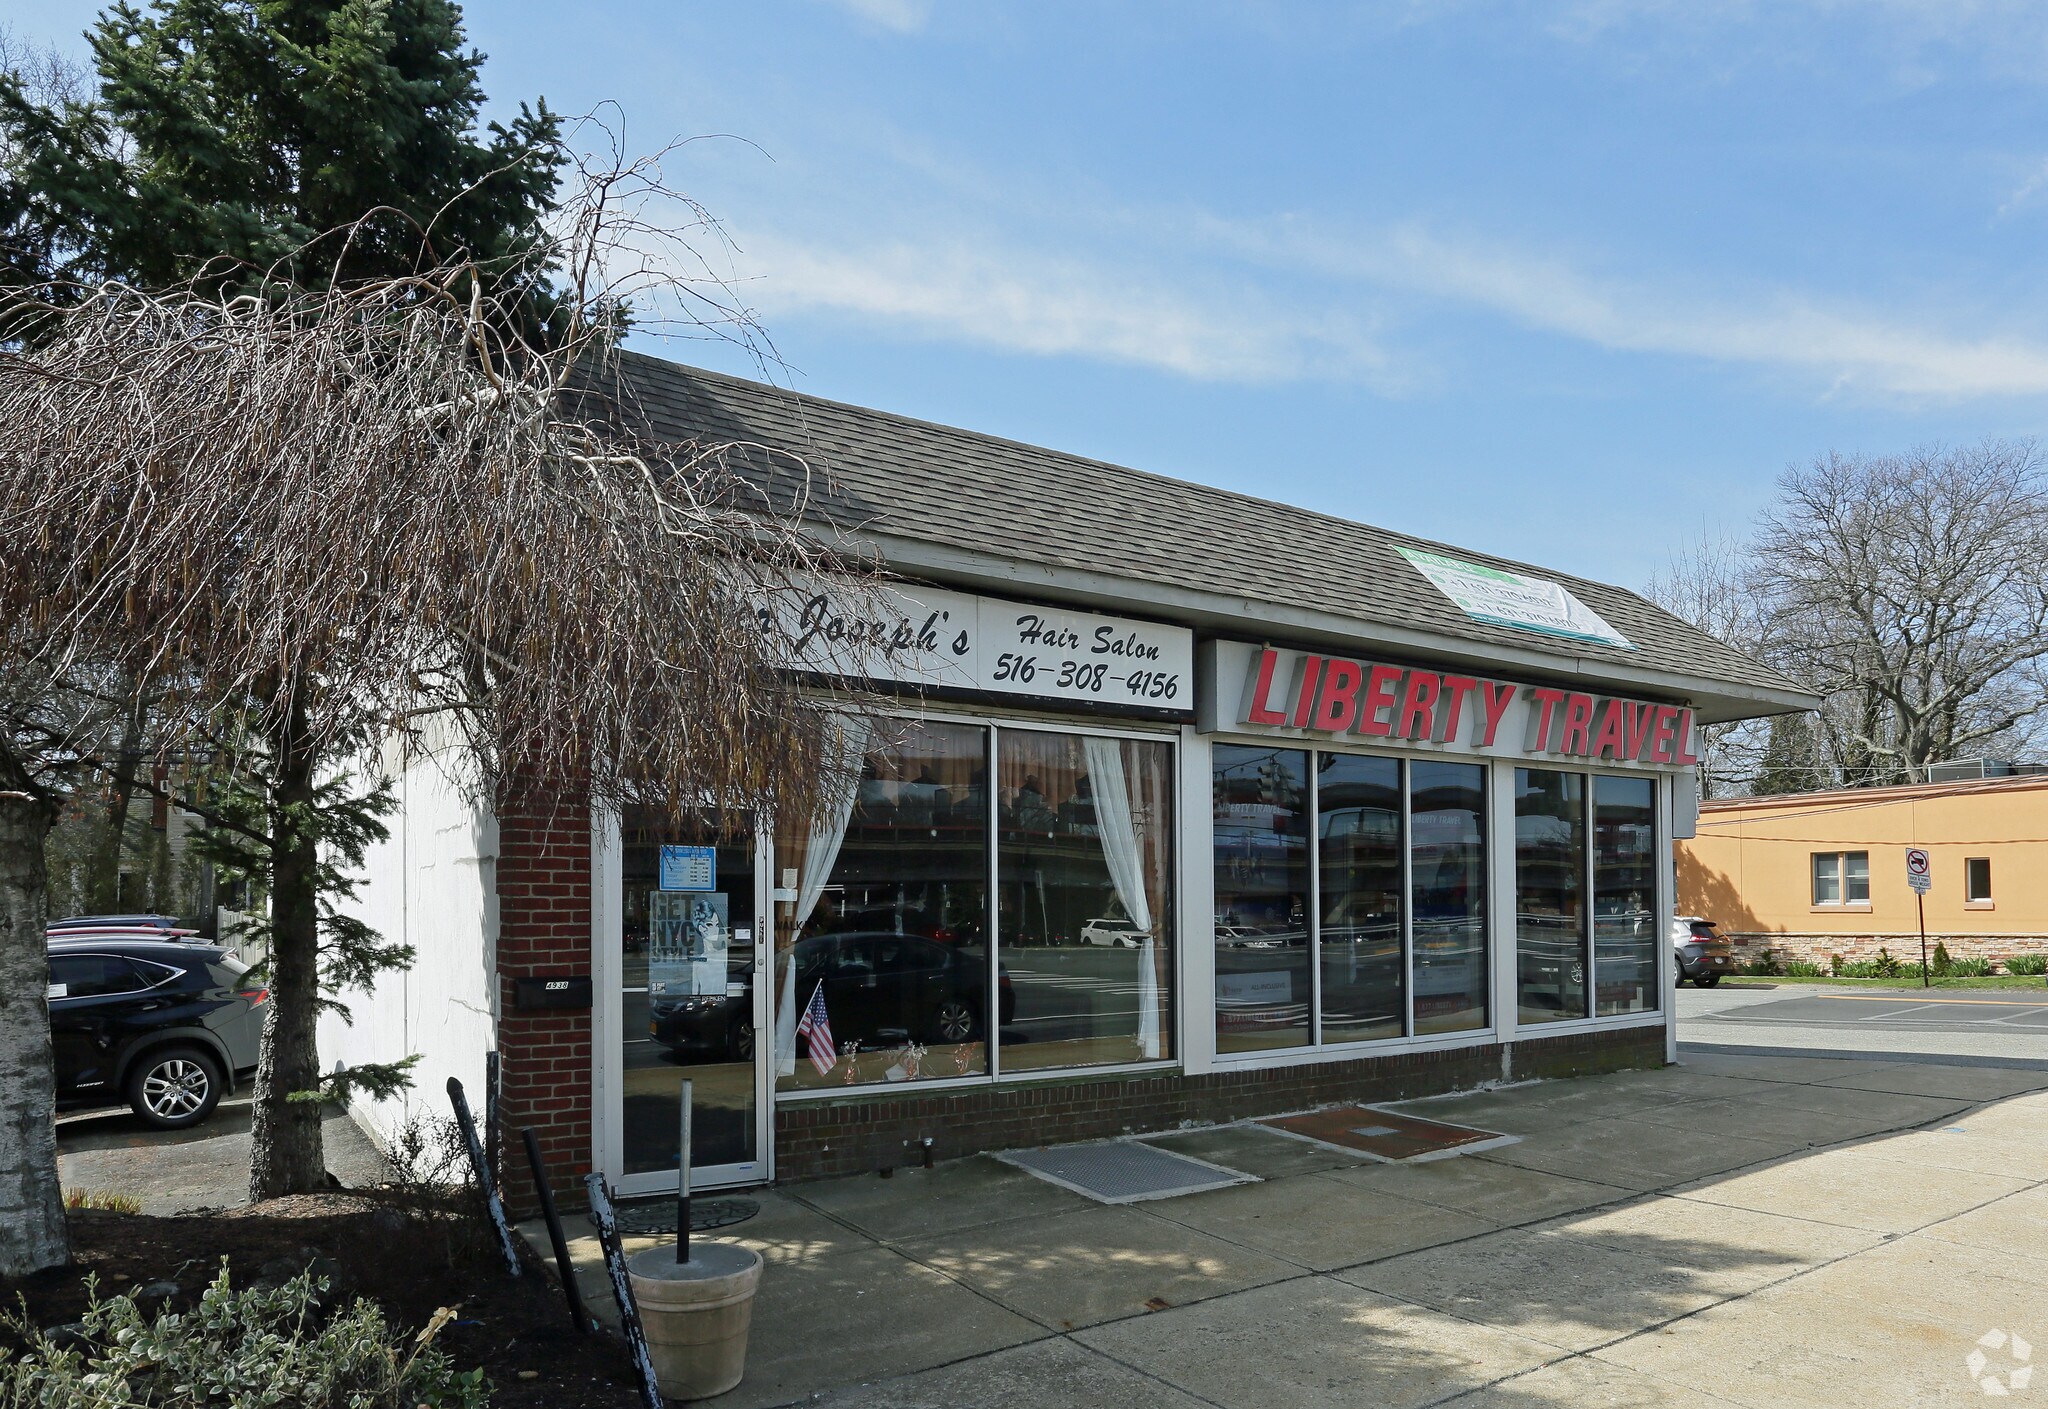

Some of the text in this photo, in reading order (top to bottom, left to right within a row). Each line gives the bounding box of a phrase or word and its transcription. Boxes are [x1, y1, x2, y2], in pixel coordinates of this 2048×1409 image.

[1016, 614, 1161, 661] Hair Salon
[993, 652, 1180, 700] 516-308-4156
[1242, 649, 1698, 767] LIBERTY TRAVEL
[1217, 802, 1281, 814] LIBERTY TRAVEL
[1412, 814, 1462, 825] LIBERTY TRAVEL
[652, 894, 696, 920] GET
[652, 921, 696, 947] NYC
